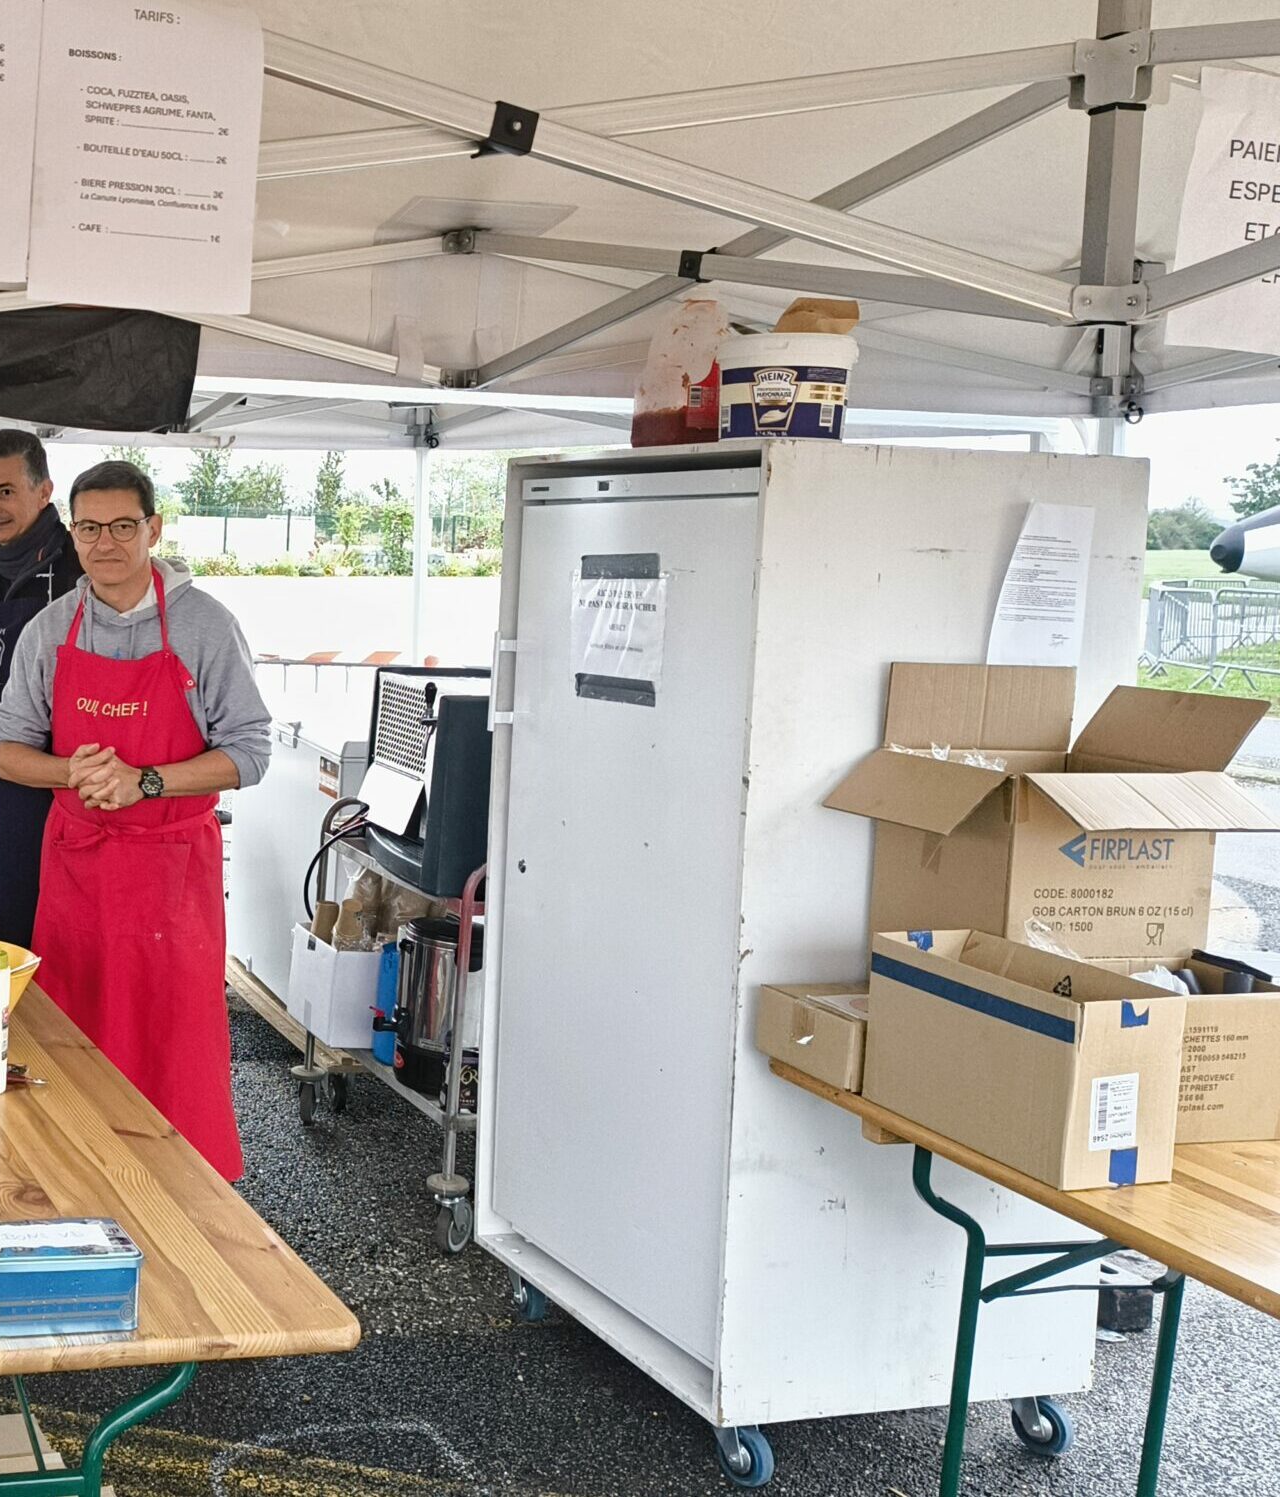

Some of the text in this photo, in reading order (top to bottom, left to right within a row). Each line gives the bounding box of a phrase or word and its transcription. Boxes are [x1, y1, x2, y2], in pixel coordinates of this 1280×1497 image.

[134, 9, 174, 24] TARIFS
[69, 49, 117, 61] BOISSONS
[87, 86, 189, 104] COCA, FUZZTEA, OASIS,
[86, 101, 216, 121] SCHWEPPES AGRUME, FANTA,
[85, 115, 115, 126] SPRITE
[218, 127, 229, 136] 2€
[84, 144, 131, 156] BOUTEILLE
[133, 147, 159, 159] D'EAU
[161, 151, 182, 161] 50CL
[216, 156, 227, 164] 2€
[1230, 139, 1280, 163] PAIE
[81, 179, 106, 189] BIERE
[108, 181, 152, 193] PRESSION
[154, 186, 176, 195] 30CL
[213, 191, 224, 199] 3€
[78, 223, 101, 232] CAFE
[210, 235, 220, 243] 1€
[1244, 222, 1270, 241] ET
[760, 372, 790, 382] HEINZ
[77, 697, 99, 717] OUI,
[102, 702, 140, 717] CHEF
[1090, 838, 1175, 860] FIRPLAST
[1034, 888, 1113, 899] CODE: 8000182
[1032, 906, 1056, 916] GOB
[1058, 906, 1103, 916] CARTON
[1106, 906, 1135, 916] BRUN
[1138, 907, 1144, 916] 6
[1147, 906, 1161, 916] OZ
[1163, 906, 1179, 917] (15
[1070, 922, 1093, 931] 1500
[1184, 1035, 1220, 1043] CHETTES
[1193, 1073, 1235, 1082] PROVENCE
[1177, 1104, 1224, 1112] irplast.com
